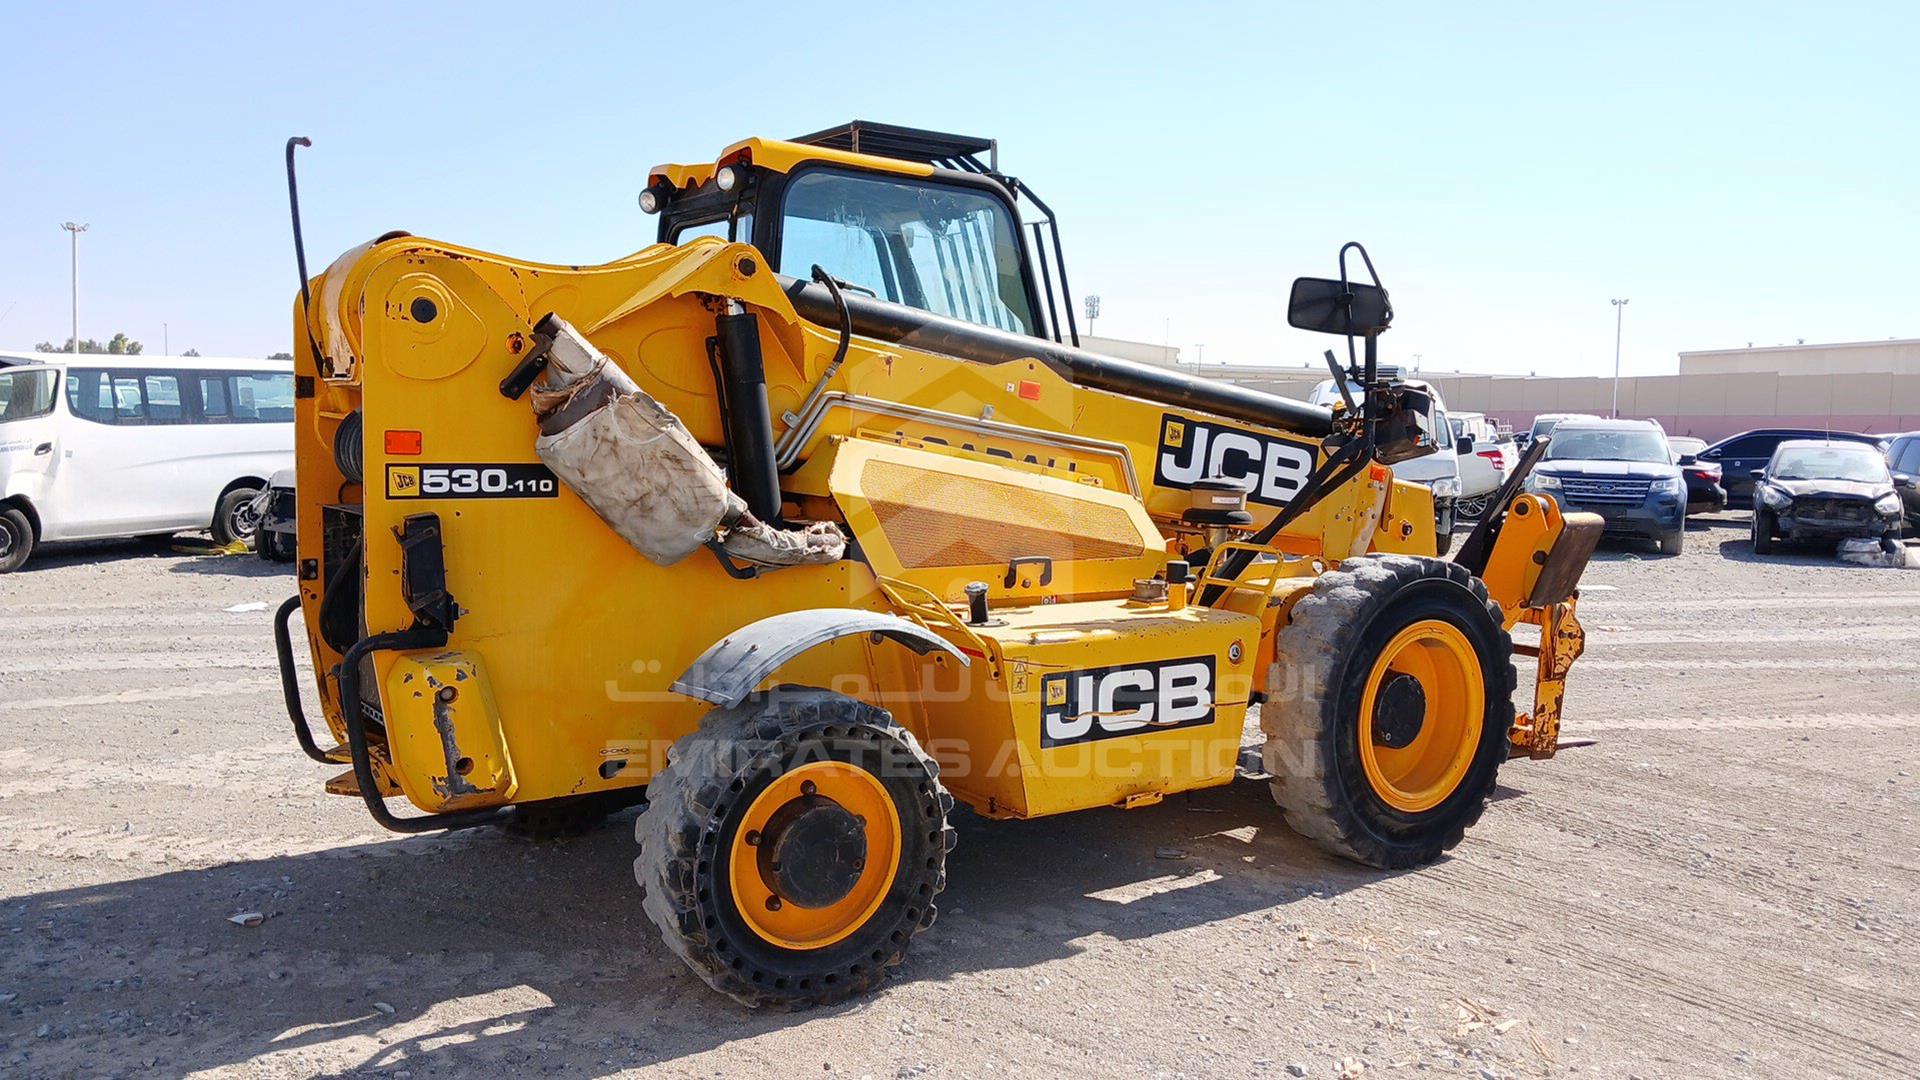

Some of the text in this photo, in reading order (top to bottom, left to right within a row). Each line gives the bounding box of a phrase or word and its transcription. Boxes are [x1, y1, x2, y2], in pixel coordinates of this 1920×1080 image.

[396, 474, 415, 489] JCB
[422, 469, 553, 493] 530-110
[1161, 426, 1312, 502] JCB
[1046, 662, 1212, 740] JCB
